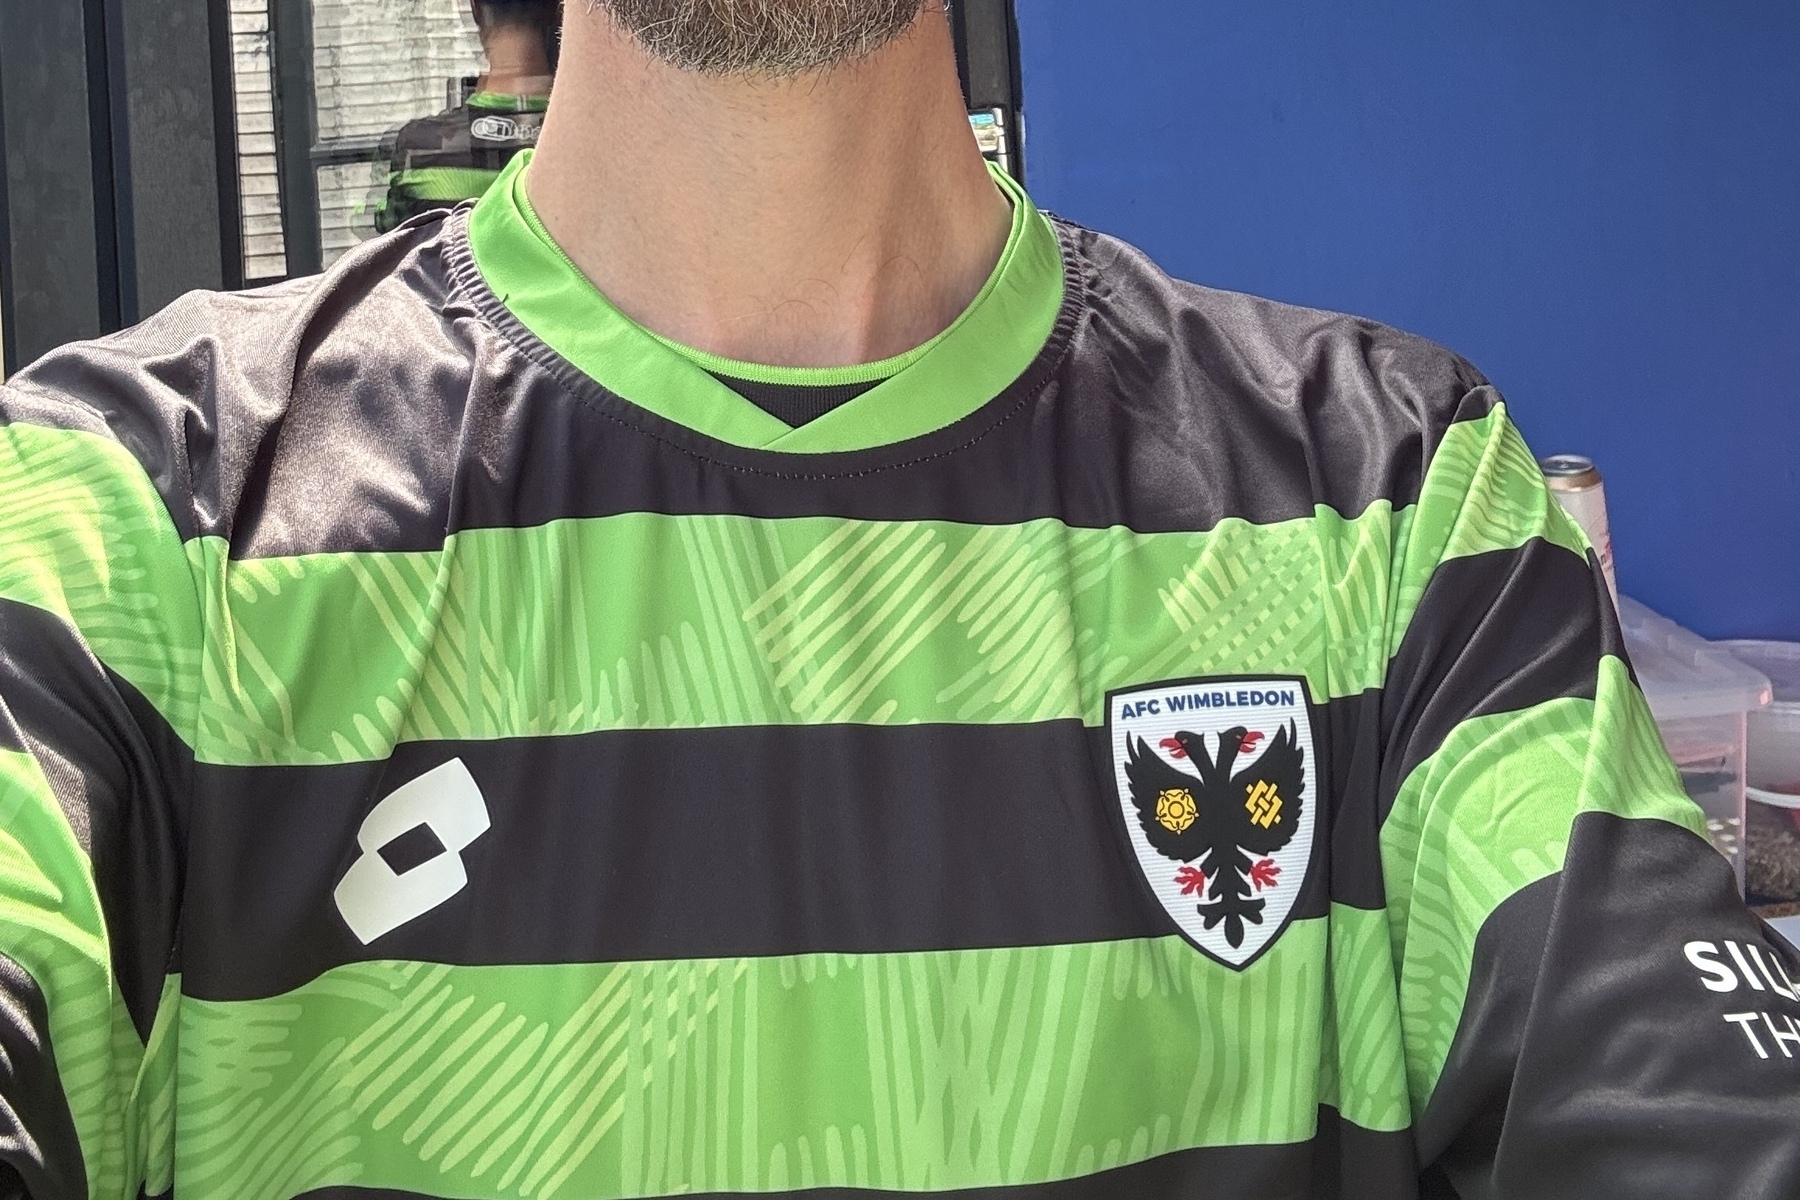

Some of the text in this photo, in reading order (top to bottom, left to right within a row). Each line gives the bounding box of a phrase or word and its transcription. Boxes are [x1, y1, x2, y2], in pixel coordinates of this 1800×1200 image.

[1121, 690, 1295, 720] AFC WIMBLEDON
[1723, 1011, 1800, 1060] TH
